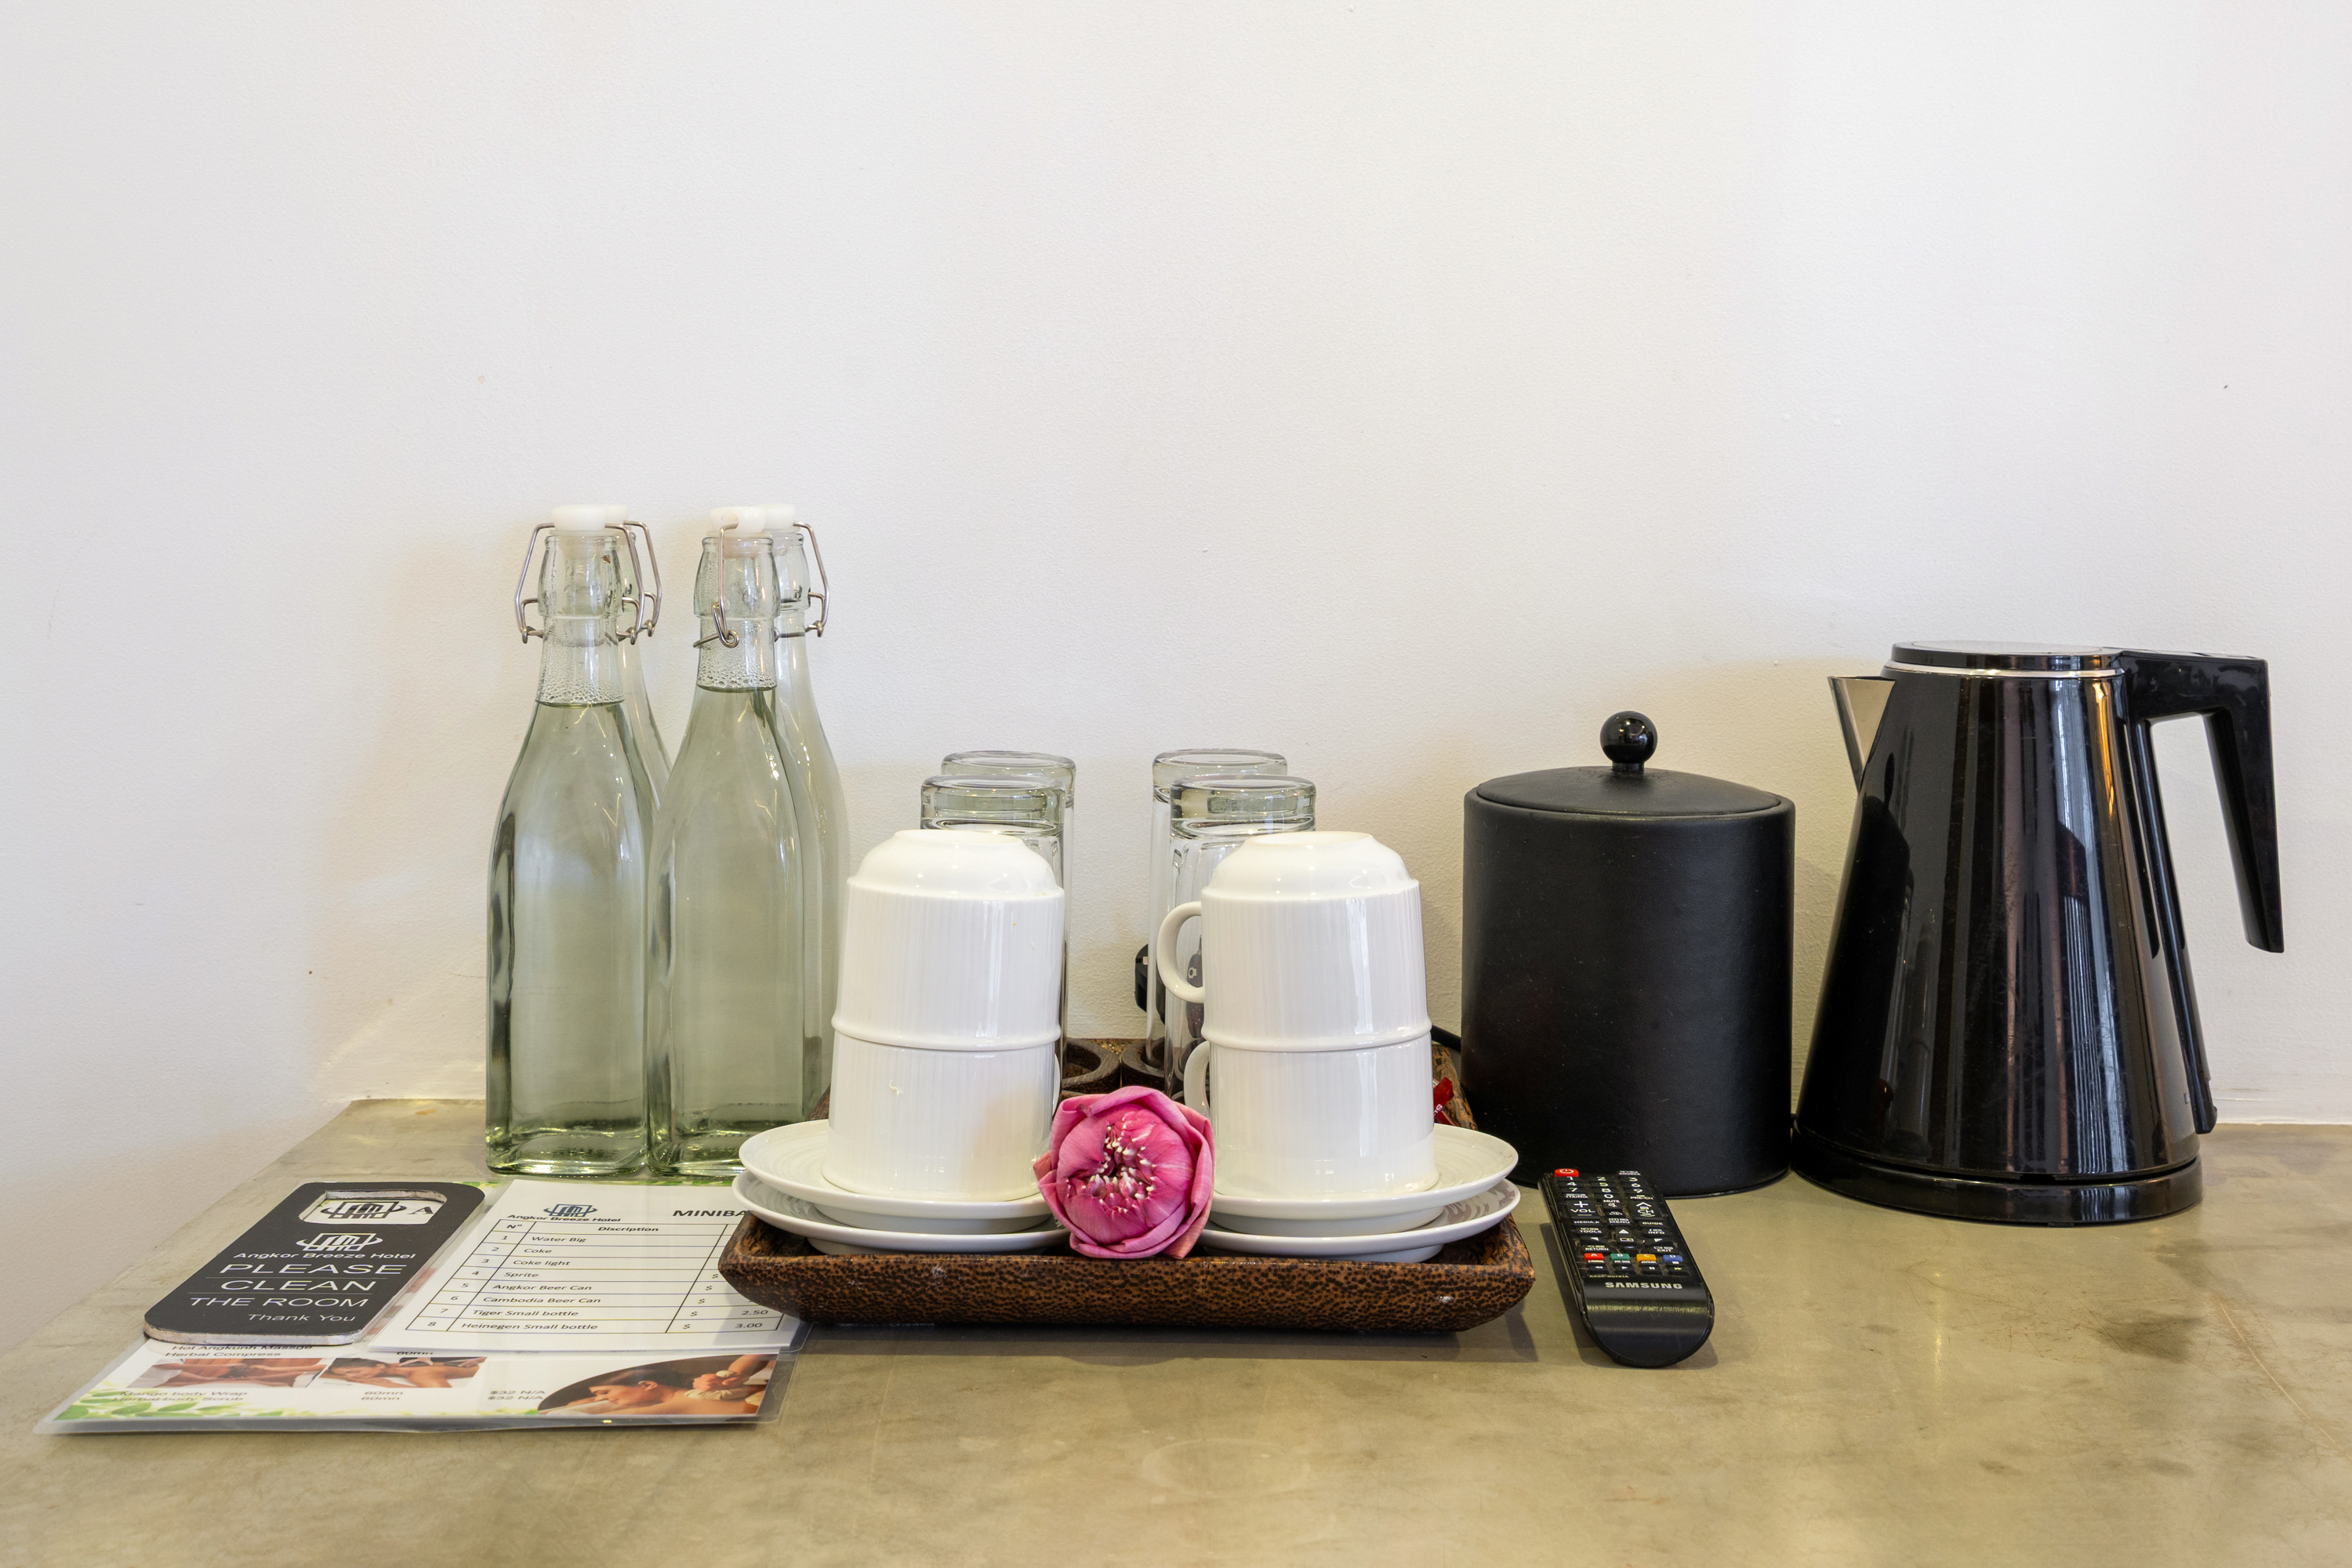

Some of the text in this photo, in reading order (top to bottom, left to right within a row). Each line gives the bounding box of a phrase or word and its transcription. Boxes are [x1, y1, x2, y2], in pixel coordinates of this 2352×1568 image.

[220, 1264, 407, 1274] PLEASE
[220, 1280, 376, 1290] CLEAN
[191, 1298, 368, 1307] THE ROOM
